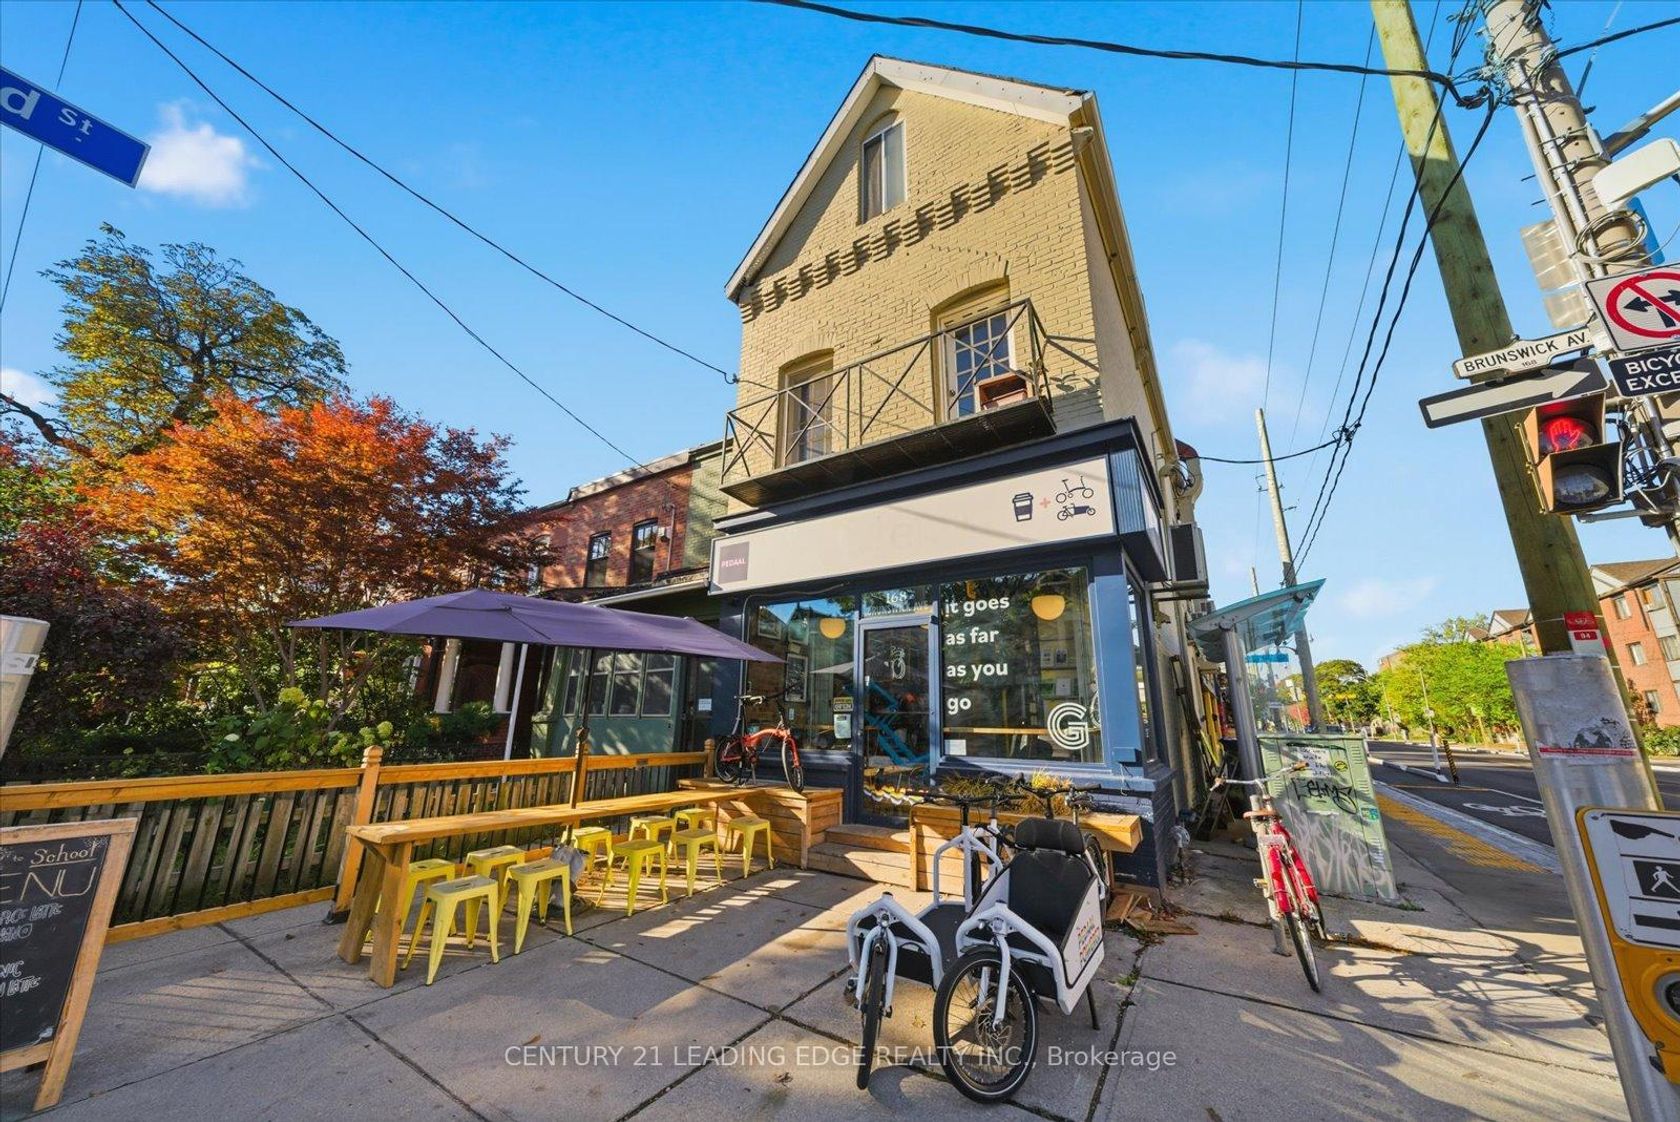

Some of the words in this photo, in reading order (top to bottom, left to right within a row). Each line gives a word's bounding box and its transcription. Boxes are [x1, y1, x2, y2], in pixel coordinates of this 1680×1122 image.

[58, 108, 93, 135] St
[1464, 341, 1559, 373] BRUNSWICK
[1567, 332, 1591, 347] AV.
[886, 591, 908, 605] 168
[945, 599, 959, 614] it
[963, 597, 1010, 617] goes
[946, 633, 966, 646] as
[970, 626, 1000, 644] far
[946, 664, 967, 678] as
[971, 662, 1009, 681] you
[947, 697, 972, 715] go
[1047, 702, 1090, 750] G
[30, 841, 97, 865] School
